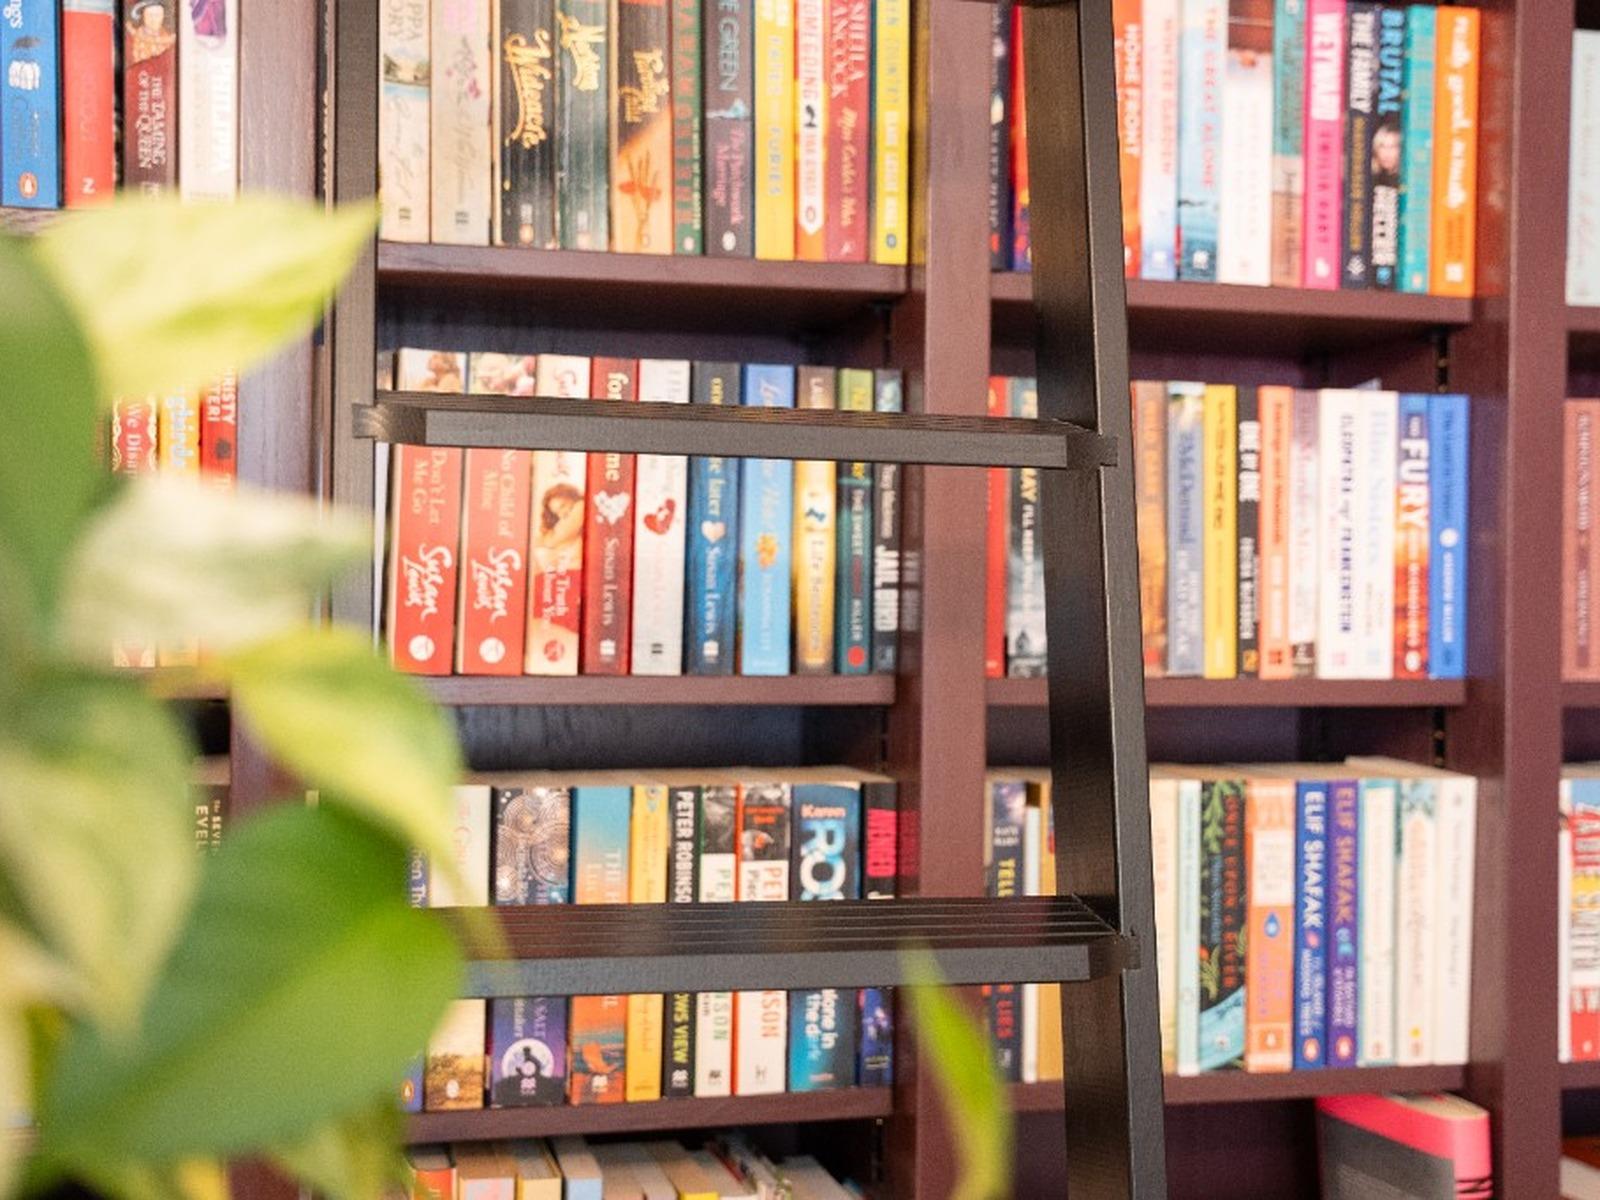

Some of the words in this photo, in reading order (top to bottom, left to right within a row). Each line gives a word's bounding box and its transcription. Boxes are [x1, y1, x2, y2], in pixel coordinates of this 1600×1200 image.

[1377, 10, 1406, 116] BRUTAL
[767, 127, 785, 197] FURIES
[1400, 439, 1429, 530] FURY
[676, 790, 695, 837] PETER
[1304, 791, 1326, 834] ELIF
[1336, 786, 1356, 831] ELIF
[997, 858, 1016, 897] TELL
[1303, 840, 1325, 928] SHAFAK
[1335, 836, 1356, 924] SHAFAK
